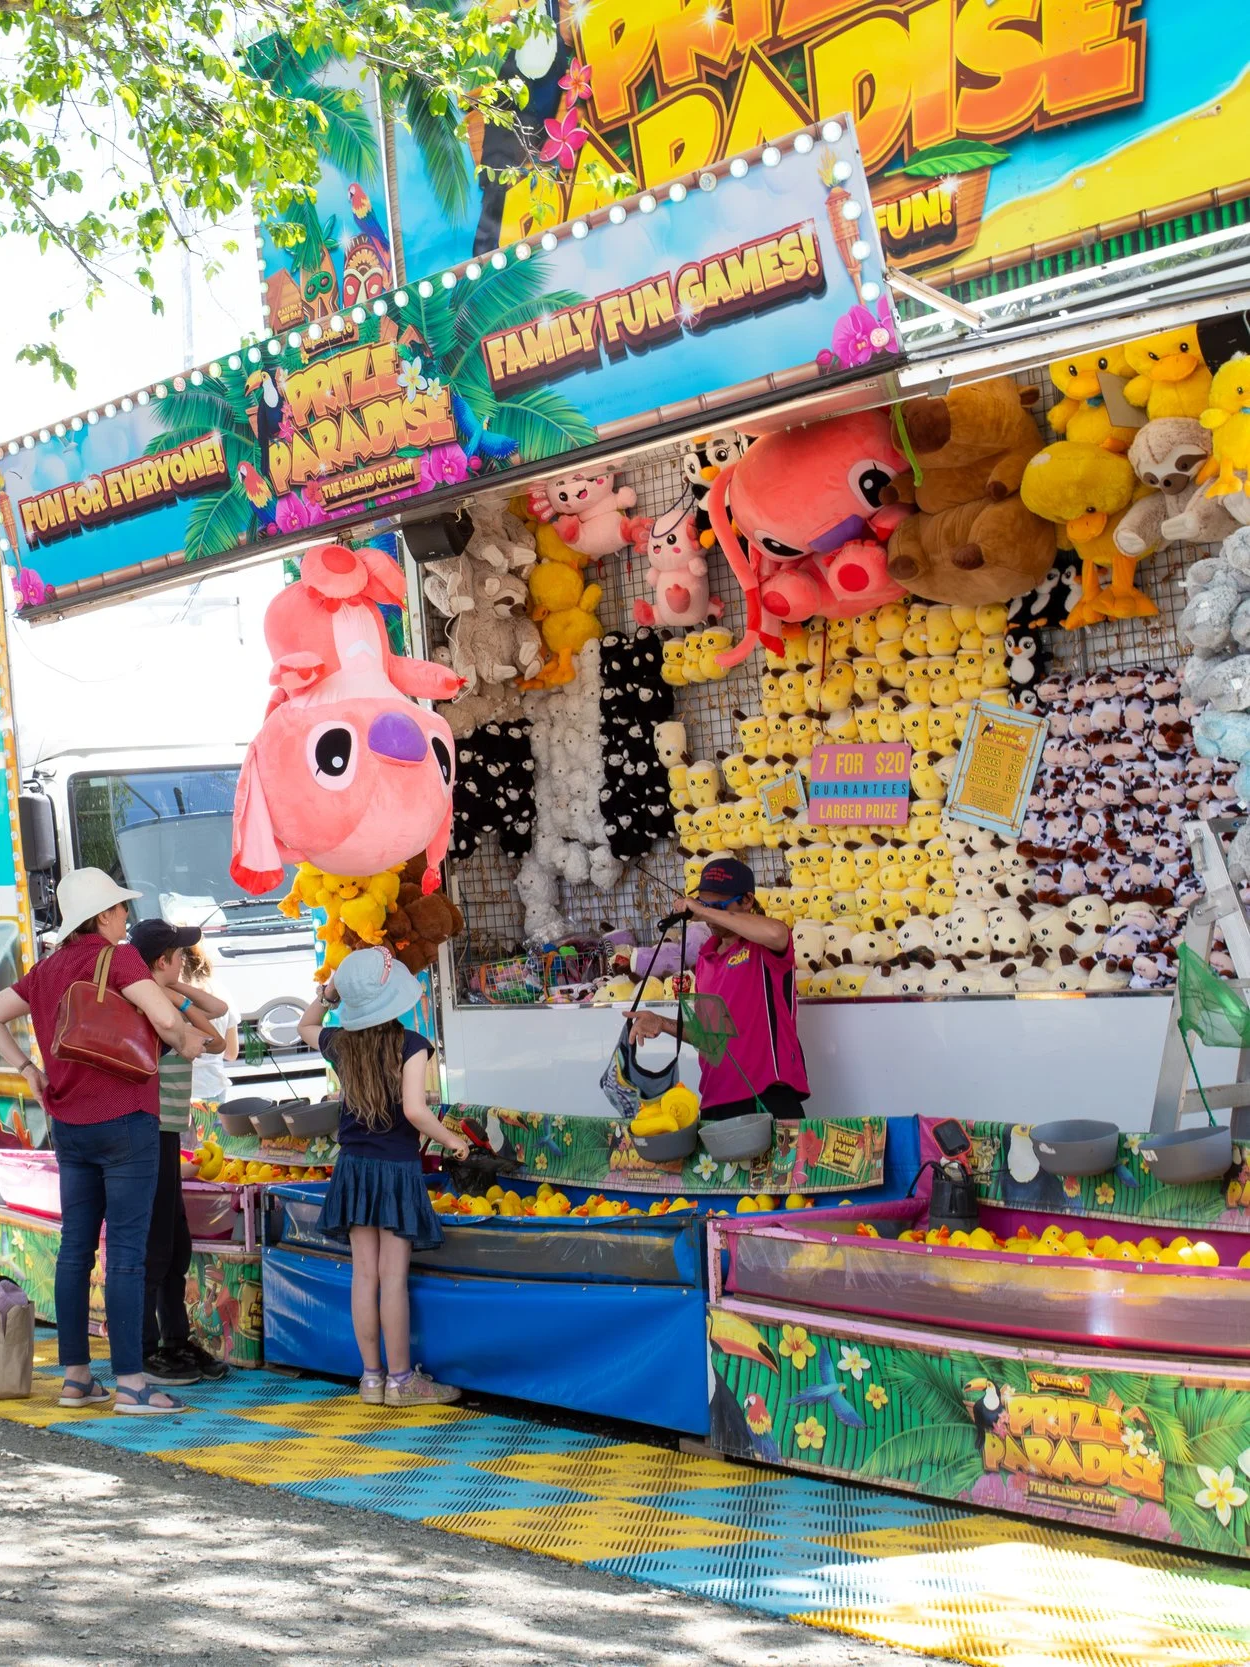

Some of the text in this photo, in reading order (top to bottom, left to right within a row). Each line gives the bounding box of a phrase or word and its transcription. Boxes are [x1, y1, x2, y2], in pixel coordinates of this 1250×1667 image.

[873, 184, 953, 239] FUN!
[488, 226, 820, 382] FAMILY FUN GAMES!
[284, 343, 400, 427] PRIZE
[269, 388, 456, 495] PARADISE
[22, 436, 225, 534] FUN FOR EVERYONE!
[322, 460, 413, 498] THE ISLAND OF FUN!
[819, 751, 905, 775] 7 FOR $20
[814, 783, 907, 796] GUARANTEES
[818, 803, 898, 819] LARGER PRIZE
[837, 1133, 858, 1146] EVERY
[1070, 1380, 1084, 1391] TO
[1006, 1395, 1124, 1446] PRIZE
[984, 1432, 1164, 1500] PARADISE
[1029, 1480, 1118, 1509] THE ISLAND OF FUN!
